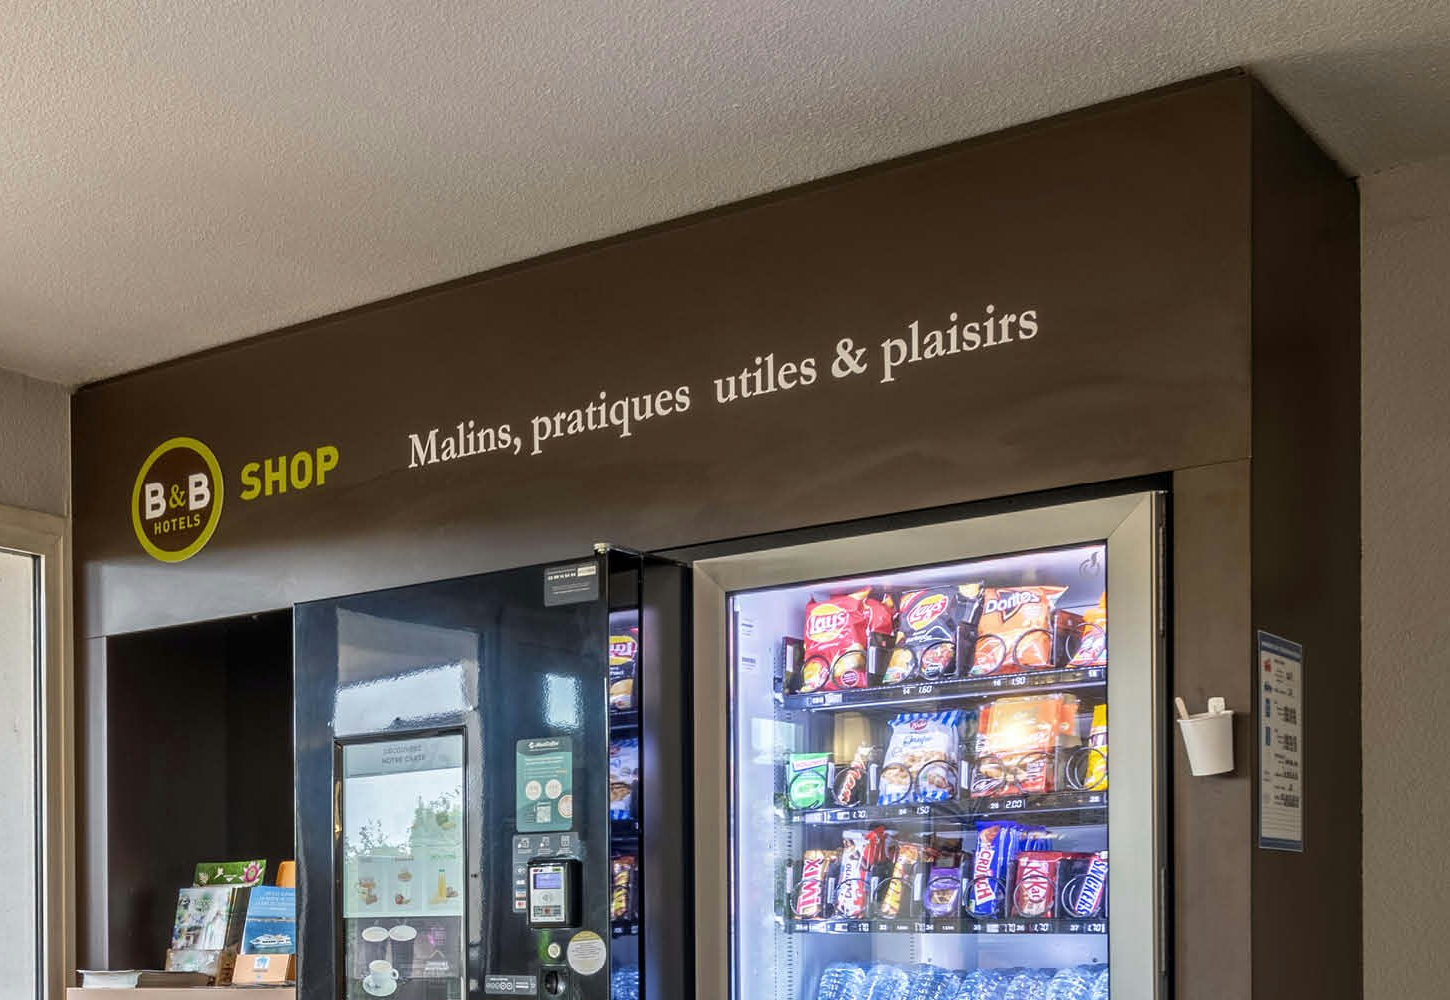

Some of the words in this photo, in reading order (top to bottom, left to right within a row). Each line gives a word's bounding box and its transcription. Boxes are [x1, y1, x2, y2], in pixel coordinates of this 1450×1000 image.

[408, 419, 522, 469] Malins,
[531, 385, 691, 456] pratiques
[713, 352, 818, 404] utiles
[831, 337, 868, 379] &
[880, 304, 1039, 384] plaisirs
[144, 472, 211, 520] B&B
[239, 445, 340, 501] SHOP
[153, 513, 201, 536] HOTELS
[985, 591, 1040, 613] Doritos
[797, 857, 823, 914] TWIX
[974, 849, 994, 901] CRUNCH
[1075, 859, 1109, 915] SNICKERS
